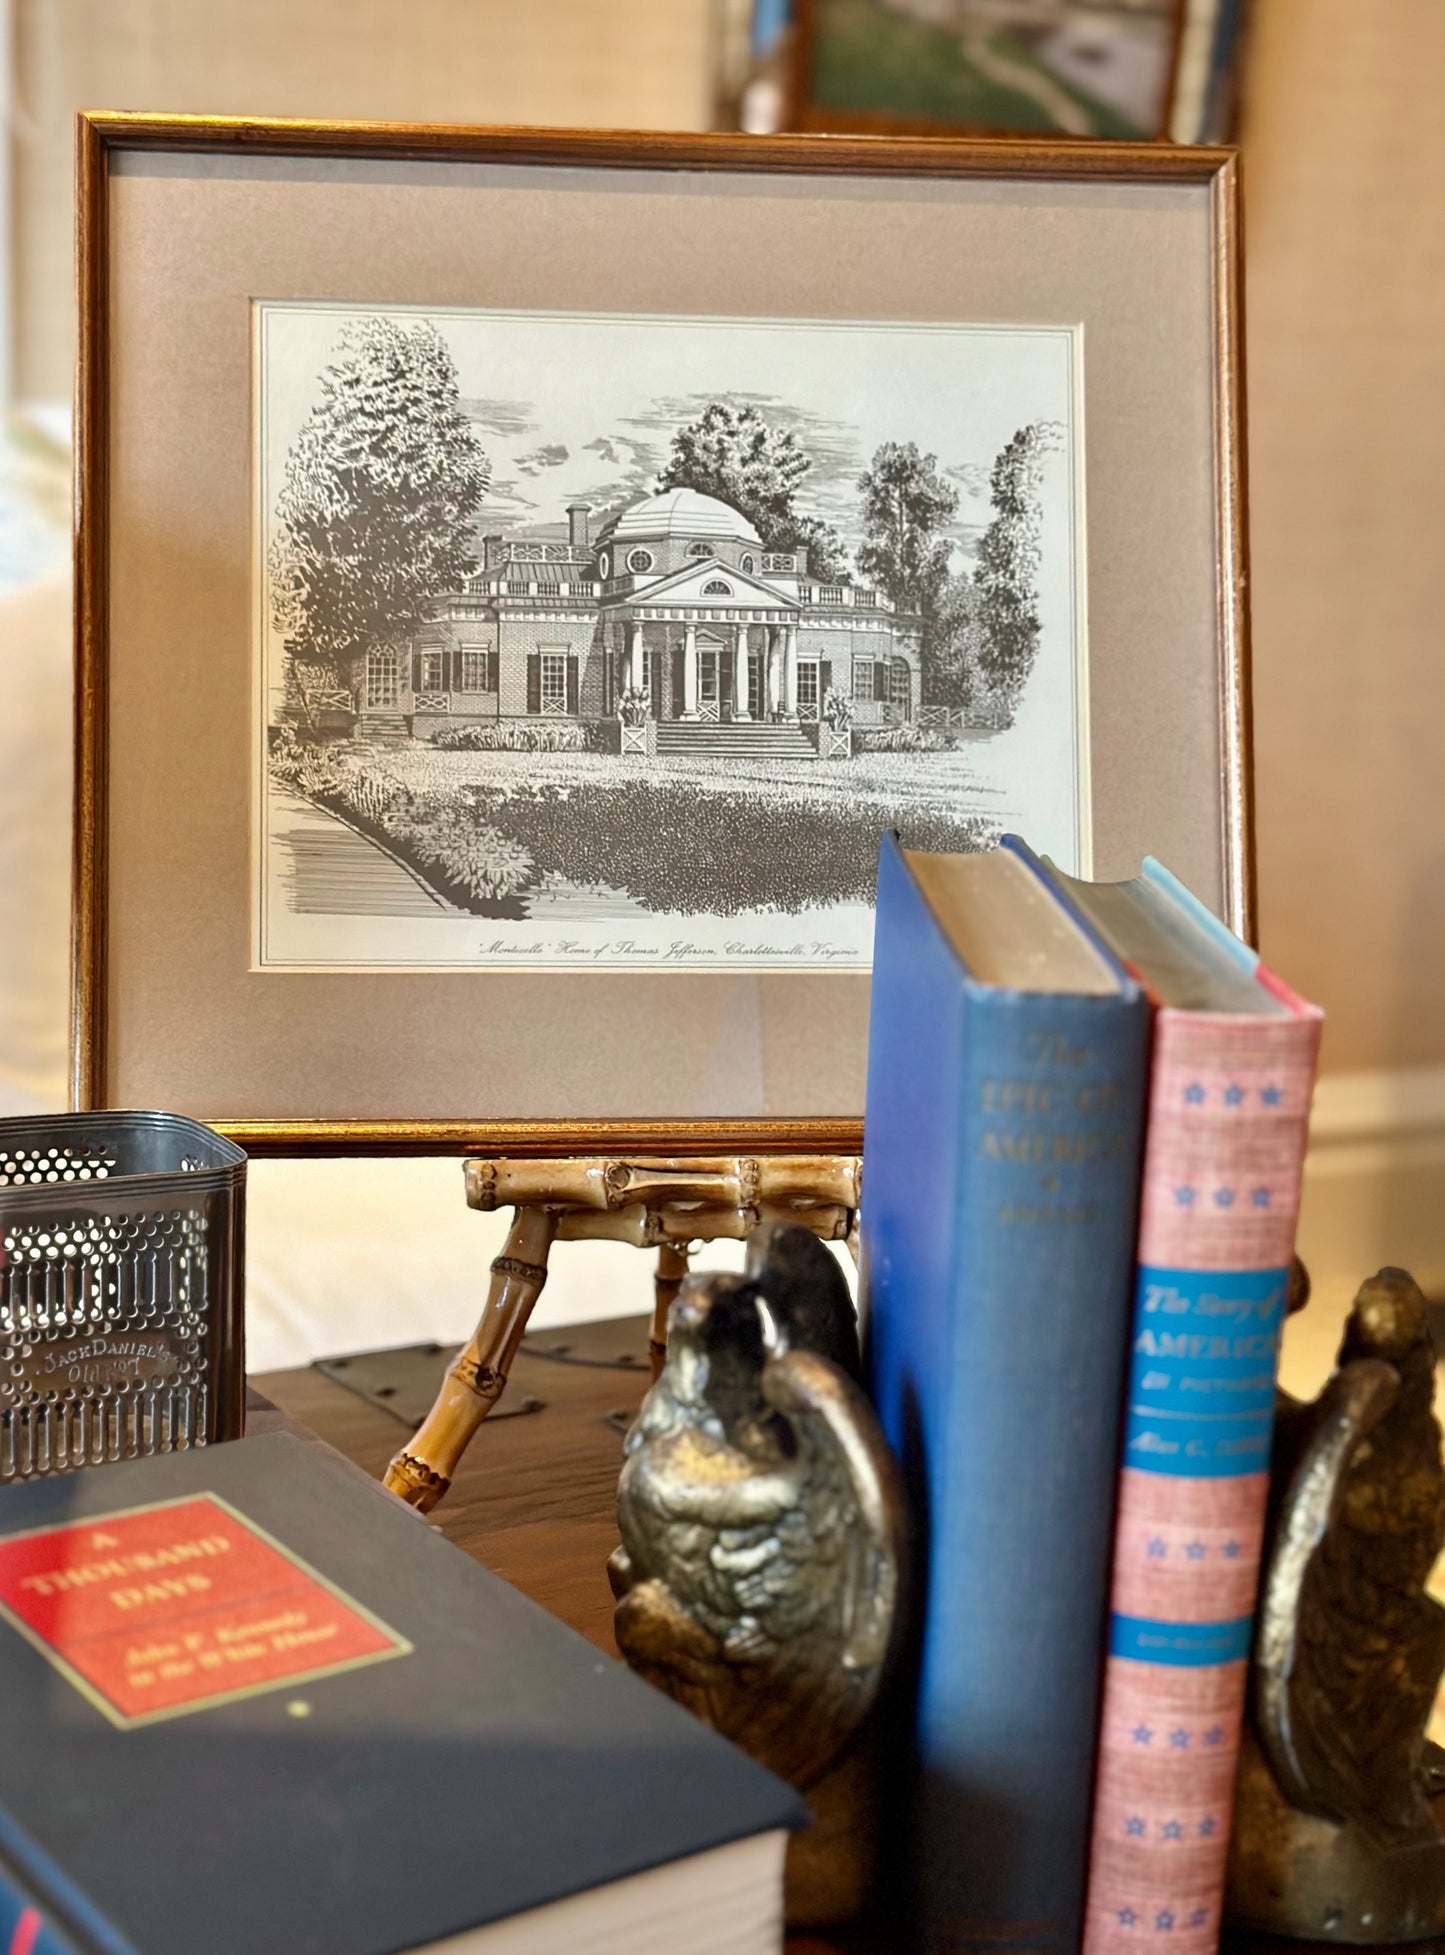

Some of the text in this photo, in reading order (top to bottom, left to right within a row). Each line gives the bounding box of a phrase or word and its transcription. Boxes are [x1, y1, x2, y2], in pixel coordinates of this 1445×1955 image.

[555, 941, 592, 955] Home
[592, 943, 605, 959] of
[611, 941, 659, 955] Thomas
[810, 941, 859, 959] Virginia
[1143, 1284, 1190, 1313] The
[91, 1531, 119, 1551] A
[21, 1535, 231, 1596] THOUSAND
[110, 1574, 212, 1610] DAYS
